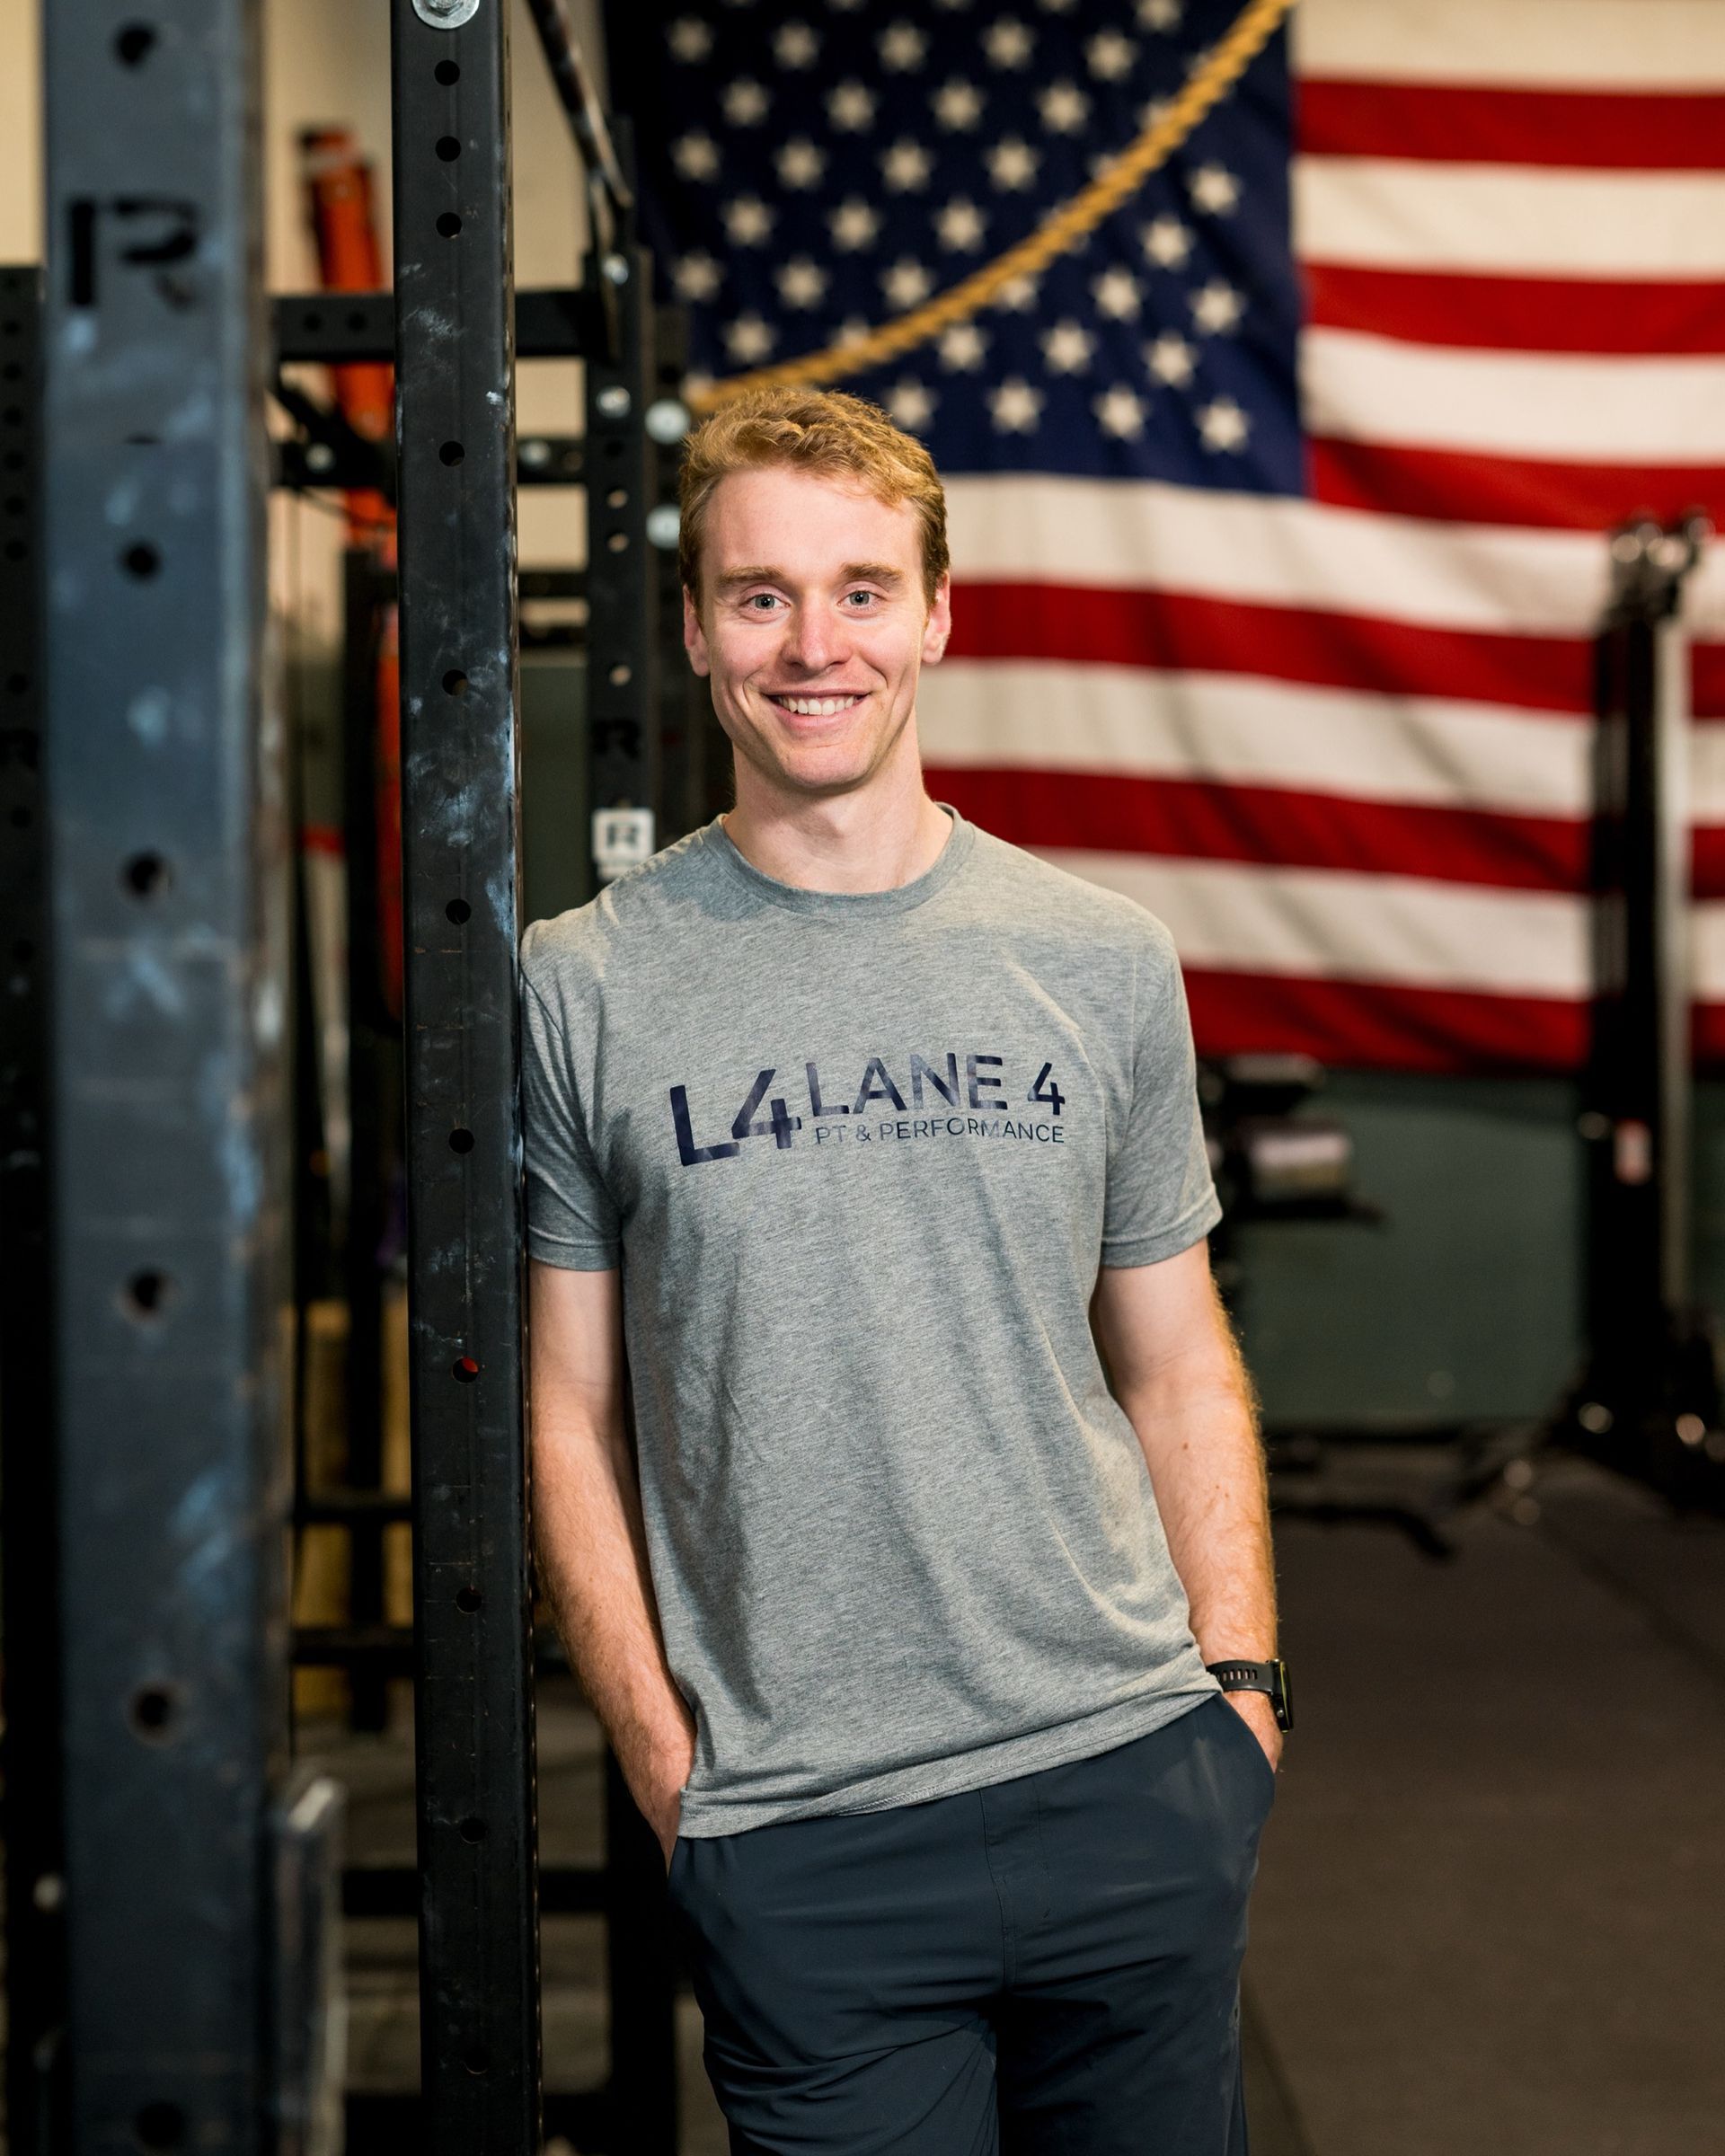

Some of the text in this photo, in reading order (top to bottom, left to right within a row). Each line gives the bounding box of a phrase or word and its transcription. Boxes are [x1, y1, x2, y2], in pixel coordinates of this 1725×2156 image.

[605, 821, 640, 848] R
[806, 1052, 1066, 1117] LANE 4
[669, 1068, 801, 1166] L4
[816, 1118, 1066, 1144] PT & PERFORMANCE
